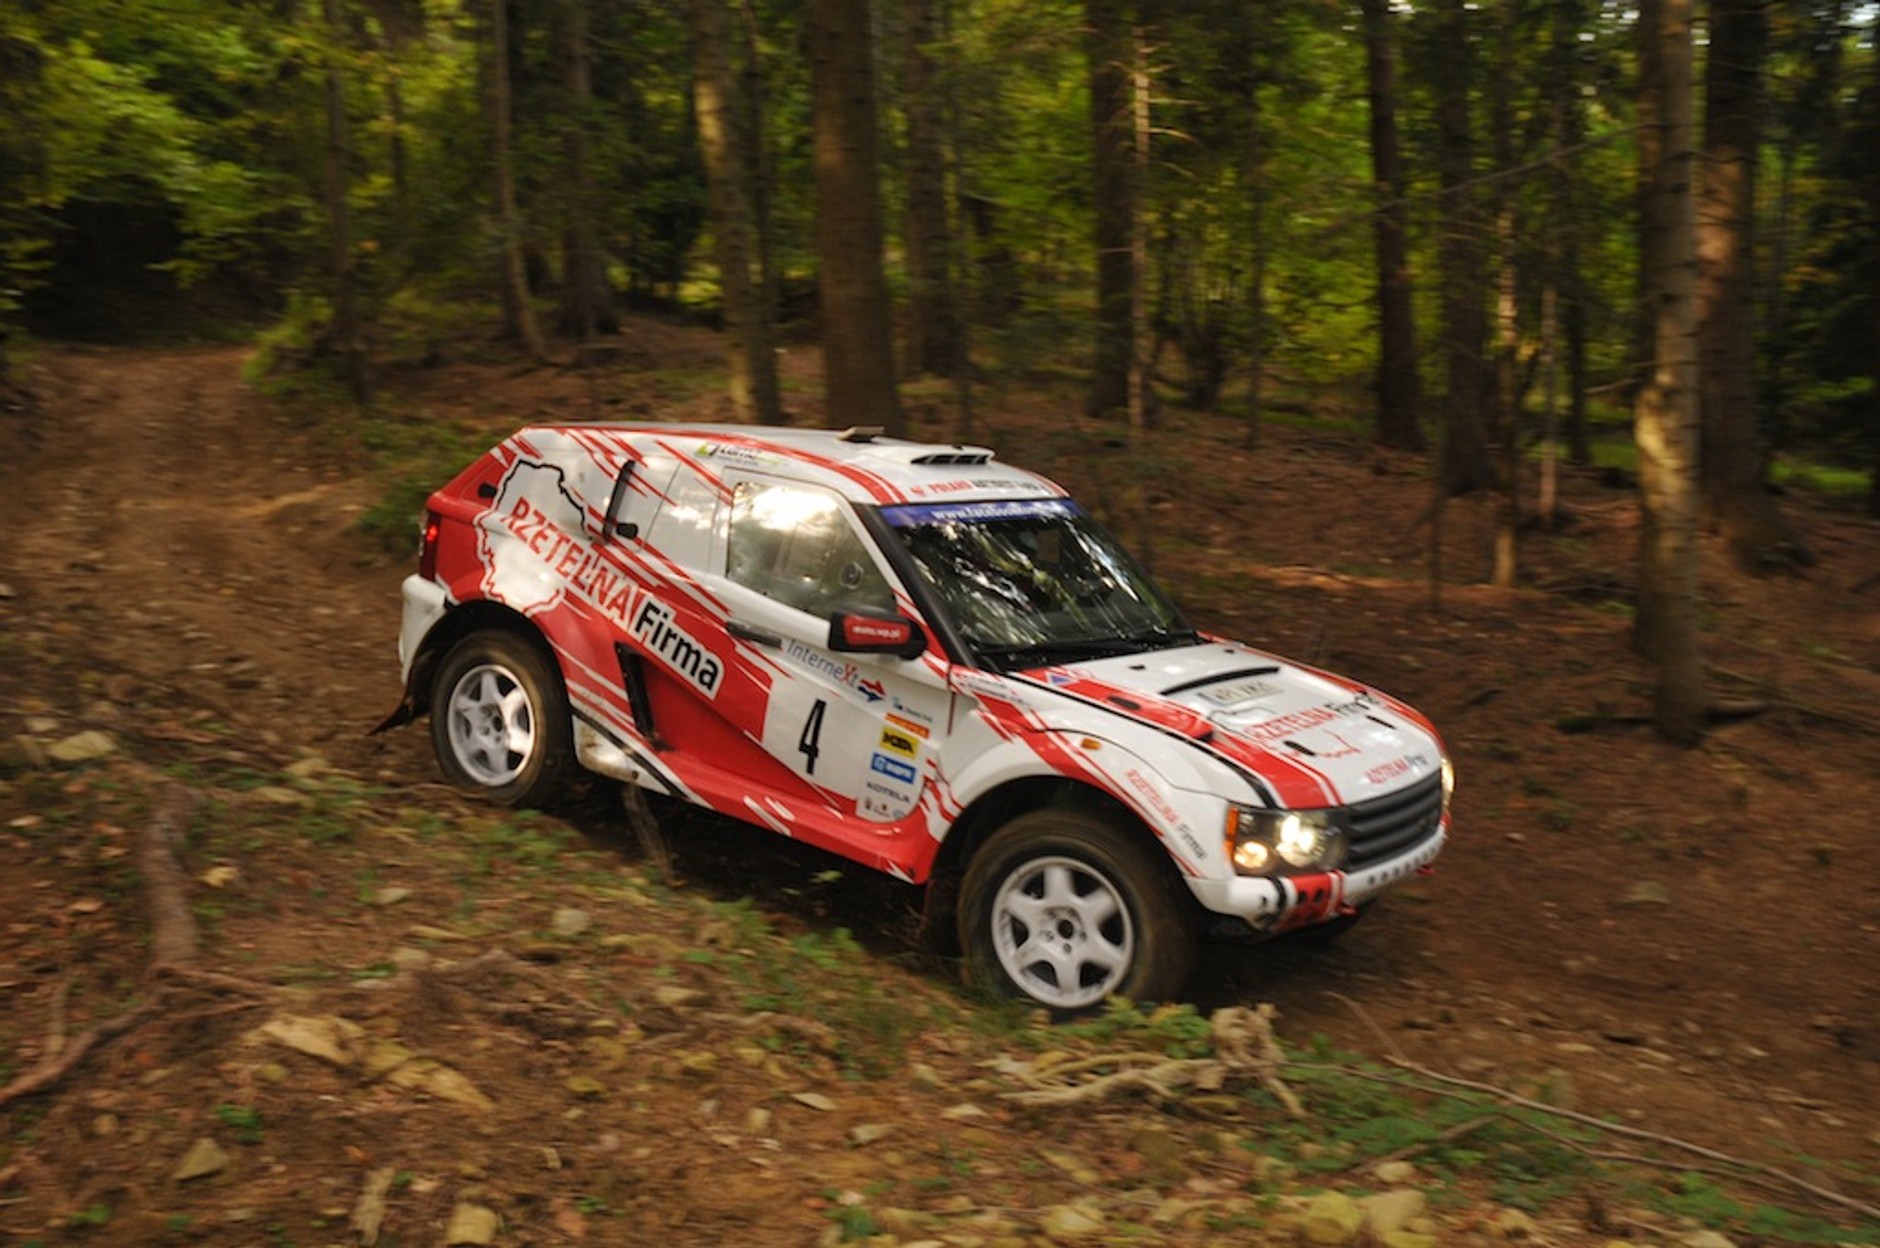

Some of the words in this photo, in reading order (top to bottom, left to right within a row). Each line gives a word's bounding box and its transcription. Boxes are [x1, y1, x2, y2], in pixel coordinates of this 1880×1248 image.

[502, 497, 631, 621] RZETELNA
[635, 601, 720, 690] Firma
[786, 640, 860, 688] InterneXt
[799, 699, 826, 775] 4
